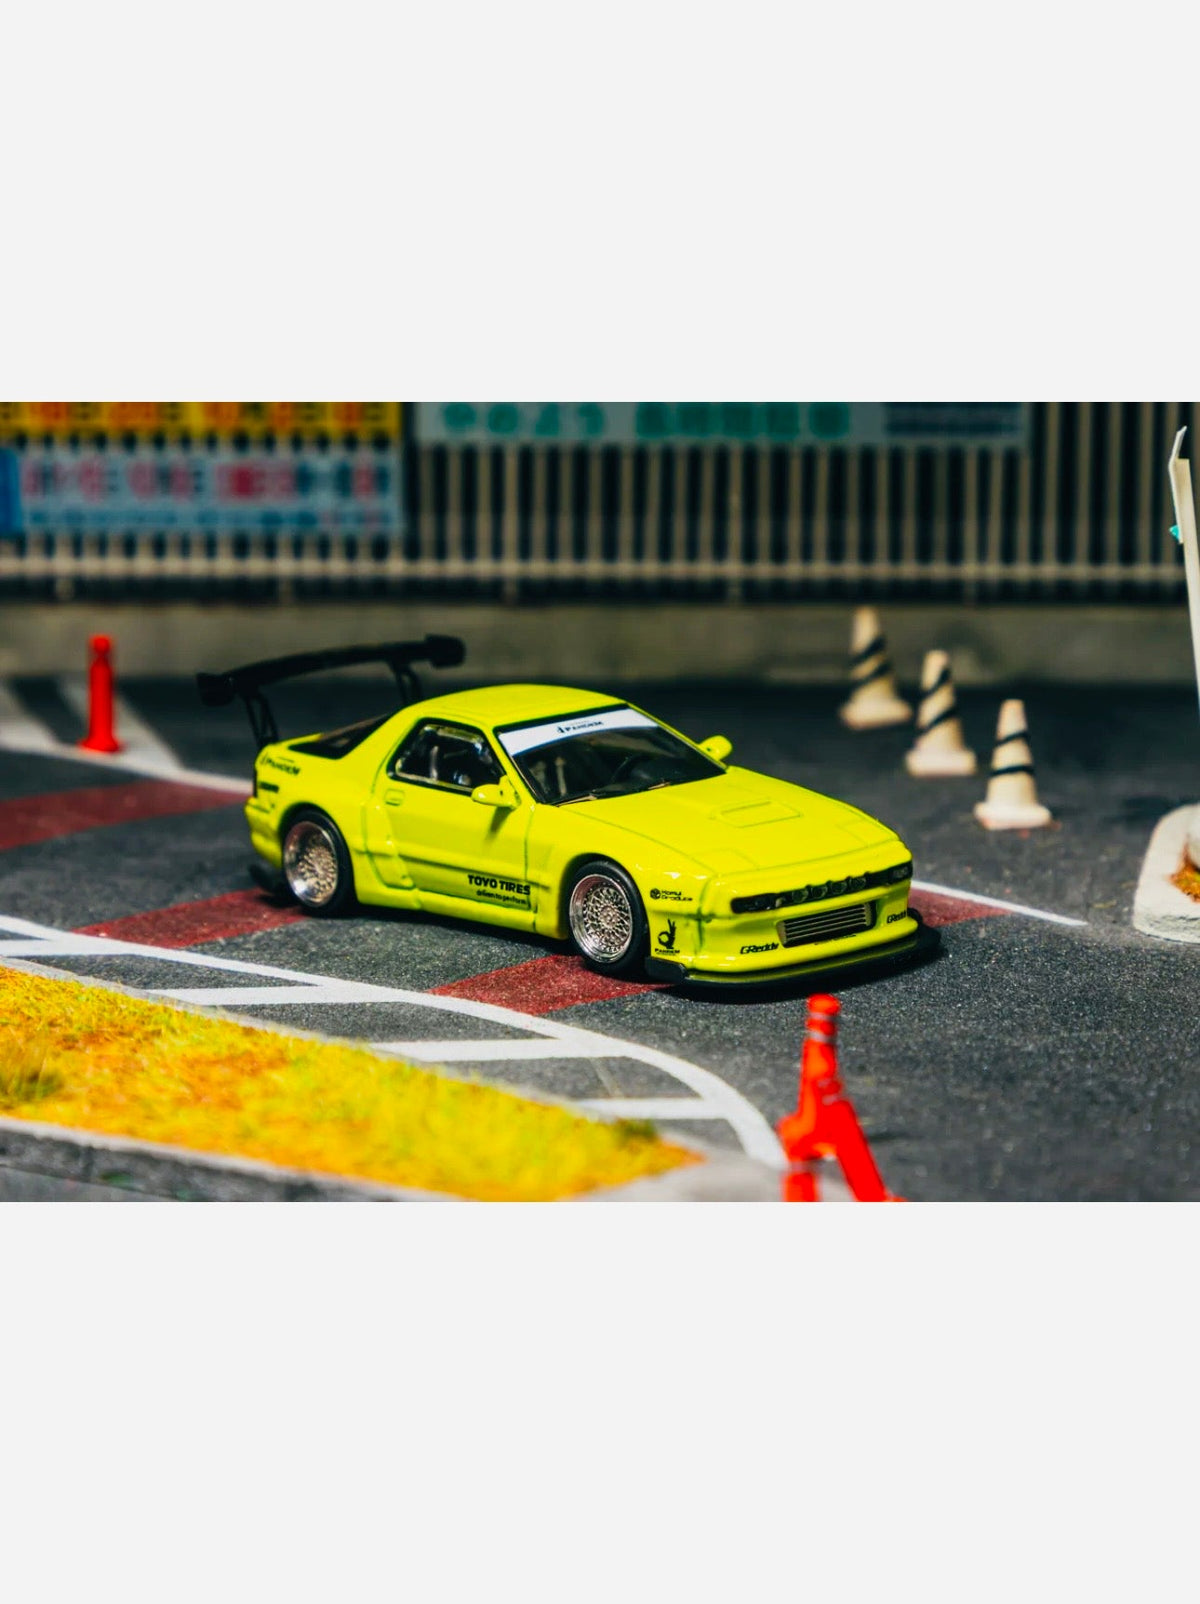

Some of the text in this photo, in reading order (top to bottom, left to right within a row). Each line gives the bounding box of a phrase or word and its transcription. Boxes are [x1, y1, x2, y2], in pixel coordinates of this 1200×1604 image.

[468, 874, 531, 896] TOYO TIRES
[887, 909, 907, 924] GRedd
[740, 942, 780, 954] GReddy
